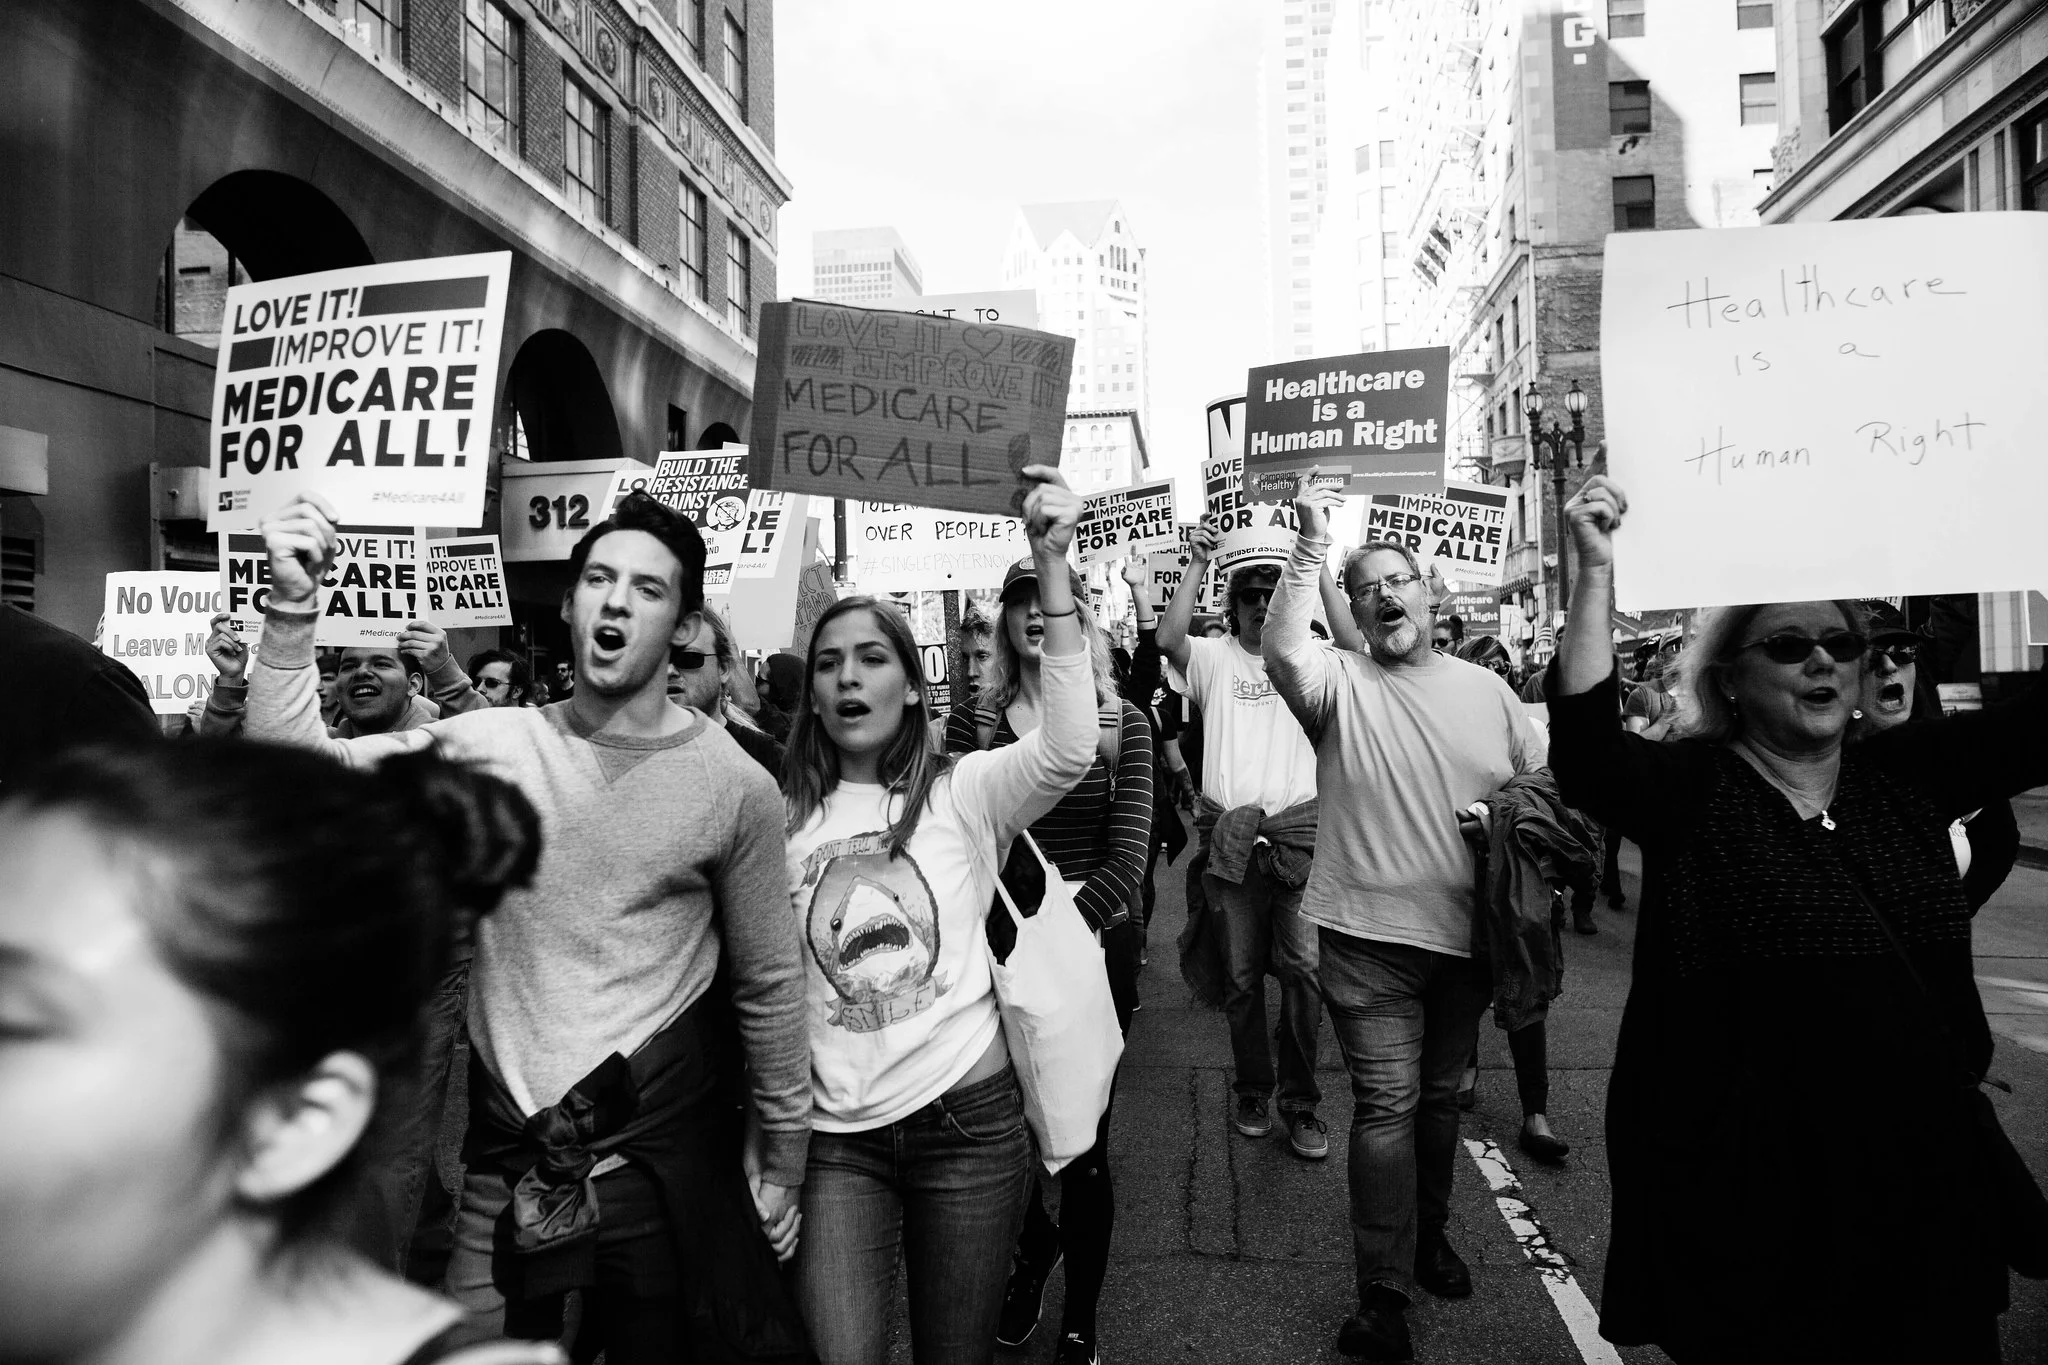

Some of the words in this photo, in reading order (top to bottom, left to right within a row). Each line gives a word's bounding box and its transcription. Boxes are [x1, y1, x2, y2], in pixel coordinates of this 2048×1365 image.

[1667, 264, 1967, 328] Healthcare
[233, 294, 312, 335] LOVE
[317, 287, 358, 322] IT!
[974, 308, 999, 323] TO
[275, 322, 427, 367] IMPROVE
[439, 319, 483, 353] IT!
[797, 306, 897, 349] LOVE
[916, 319, 949, 353] IT
[1839, 342, 1880, 358] a
[853, 351, 1023, 400] IMPROVE
[1031, 371, 1062, 408] IT
[1265, 369, 1425, 402] Healthcare
[222, 364, 478, 427] MEDICARE
[785, 377, 1007, 433] MEDICARE
[1312, 399, 1337, 422] is
[1347, 400, 1365, 419] a
[220, 424, 303, 478] FOR
[325, 419, 471, 467] ALL!
[1250, 428, 1343, 456] Human
[1353, 419, 1438, 450] Right
[1684, 425, 1810, 485] Human
[1855, 412, 1987, 466] Right
[658, 459, 707, 477] BUILD
[710, 457, 741, 475] THE
[782, 430, 864, 480] FOR
[1205, 458, 1242, 480] LOVE
[651, 474, 748, 493] RESISTANCE
[1261, 480, 1296, 491] Healthy
[529, 494, 590, 530] 312
[758, 491, 785, 506] IT!
[1096, 498, 1152, 519] IMPROVE
[1156, 495, 1171, 507] IT!
[1110, 492, 1125, 505] IT!
[1401, 496, 1479, 520] IMPROVE
[1484, 508, 1505, 524] IT!
[865, 522, 913, 541] OVER
[1076, 507, 1172, 539] MEDICARE
[1077, 532, 1118, 554] FOR
[1128, 520, 1173, 541] ALL!
[1368, 508, 1502, 545] MEDICARE
[387, 539, 415, 559] IT!
[430, 546, 446, 558] IT!
[1434, 539, 1499, 565] ALL!
[480, 557, 496, 570] IT!
[1154, 571, 1182, 584] FOR
[116, 586, 153, 614] No
[325, 591, 416, 619] ALL!
[455, 590, 503, 609] ALL!
[1471, 612, 1499, 622] Right
[113, 634, 178, 657] Leave
[842, 986, 930, 1030] SMILE
